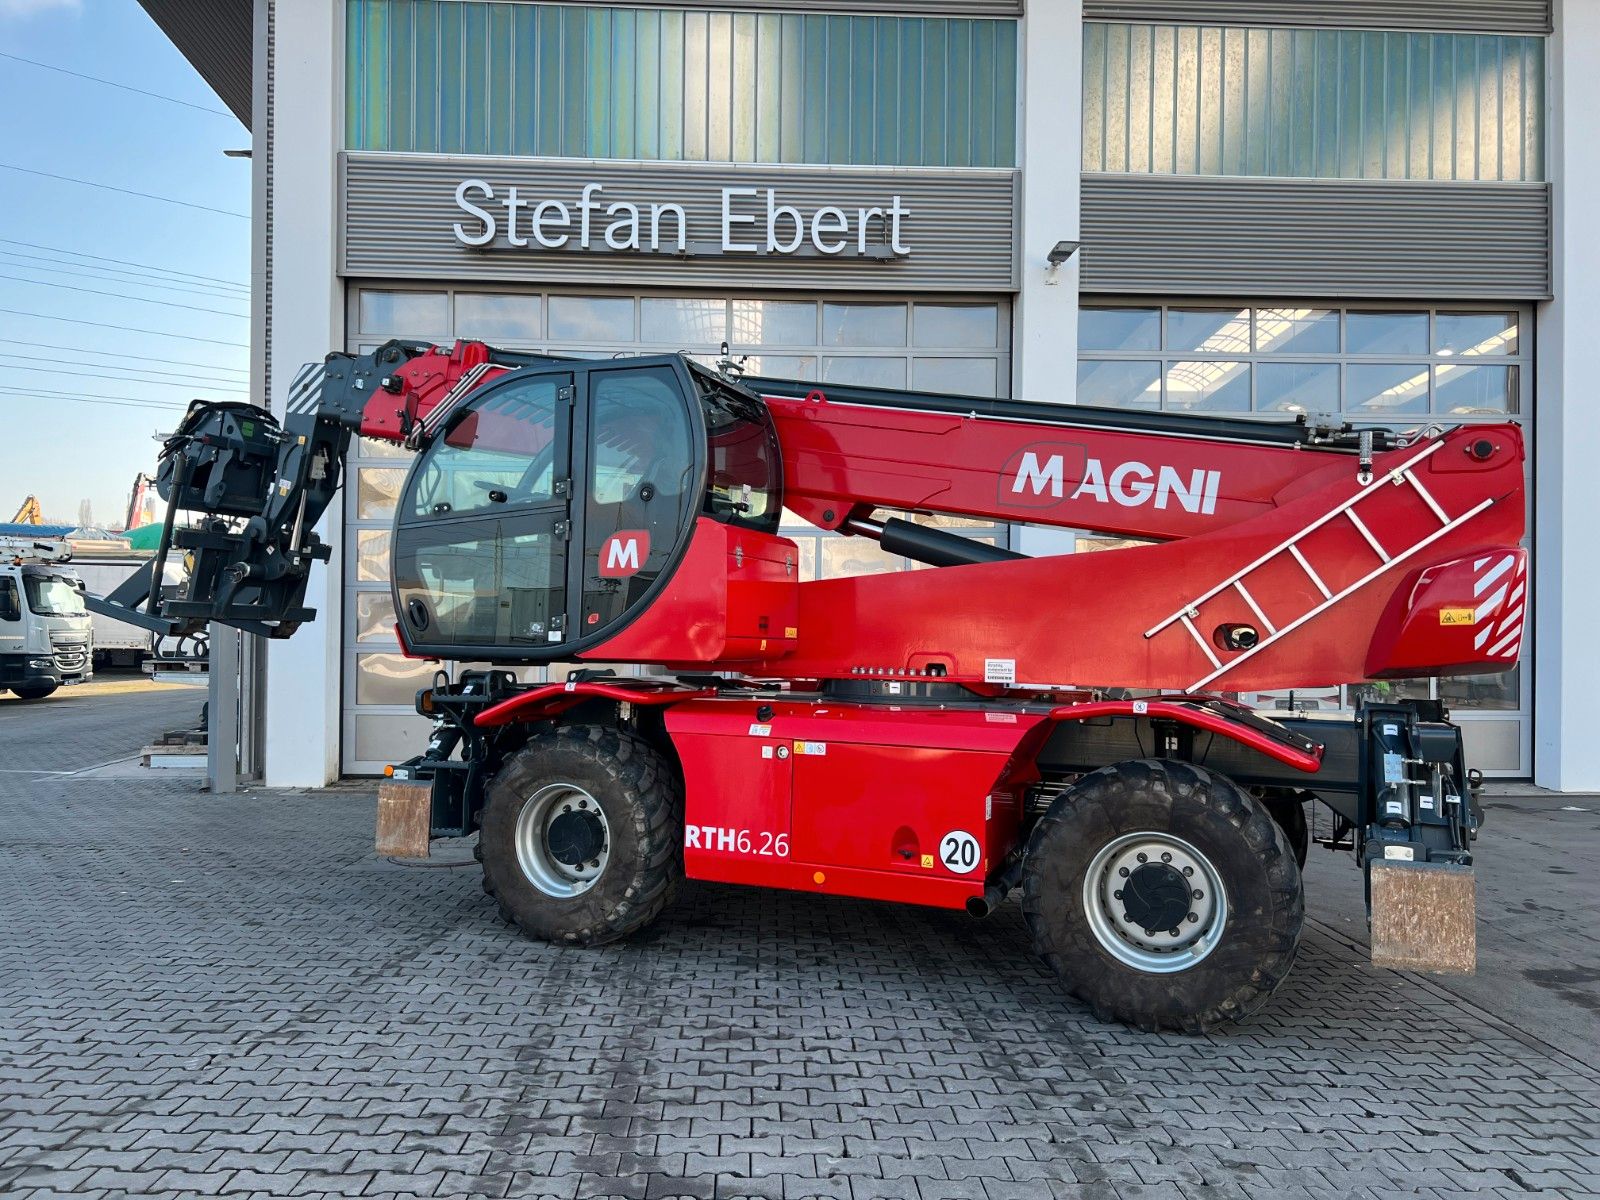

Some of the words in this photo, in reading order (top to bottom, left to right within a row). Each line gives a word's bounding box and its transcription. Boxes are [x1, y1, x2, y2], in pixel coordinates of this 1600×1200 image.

[453, 179, 687, 252] Stefan
[721, 187, 912, 255] Ebert
[1012, 452, 1221, 515] MAGNI
[606, 538, 639, 569] M
[945, 837, 975, 867] 20
